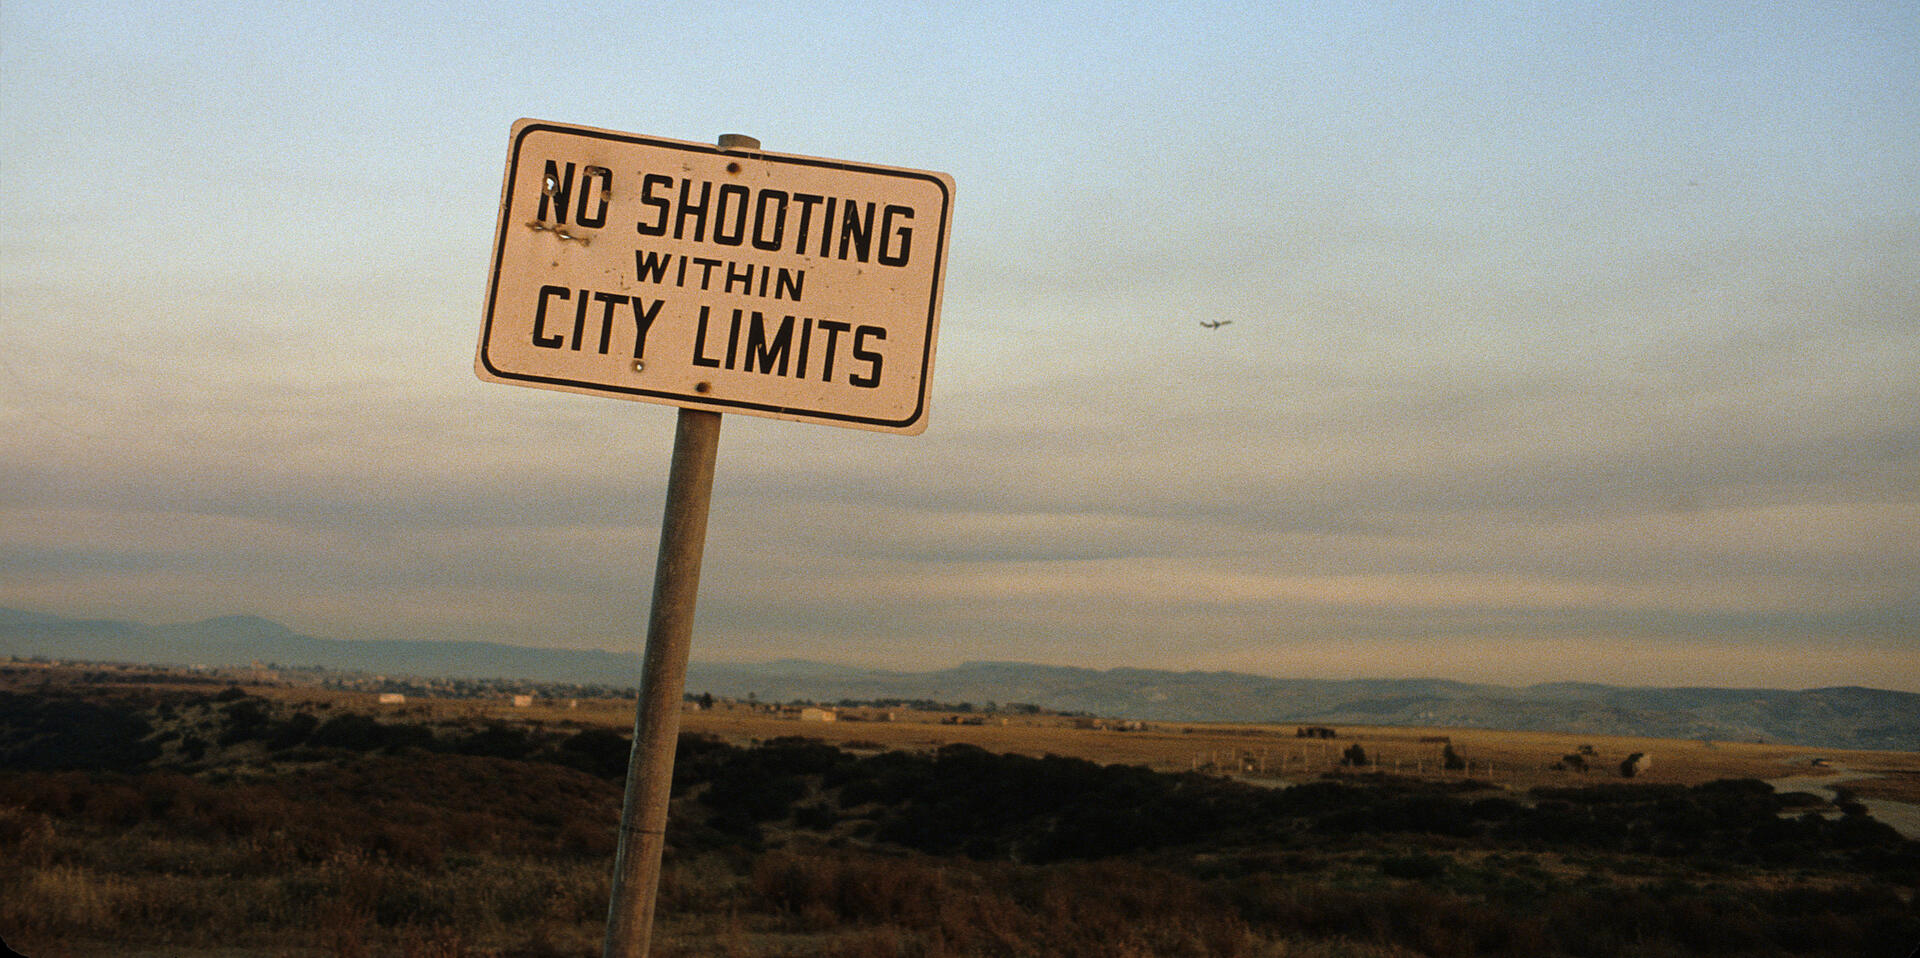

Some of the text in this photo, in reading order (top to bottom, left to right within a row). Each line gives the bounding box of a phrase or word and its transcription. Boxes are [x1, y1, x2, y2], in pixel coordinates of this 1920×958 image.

[537, 160, 915, 268] NO SHOOTING
[635, 250, 805, 302] WITHIN
[532, 285, 887, 389] CITY LIMITS
